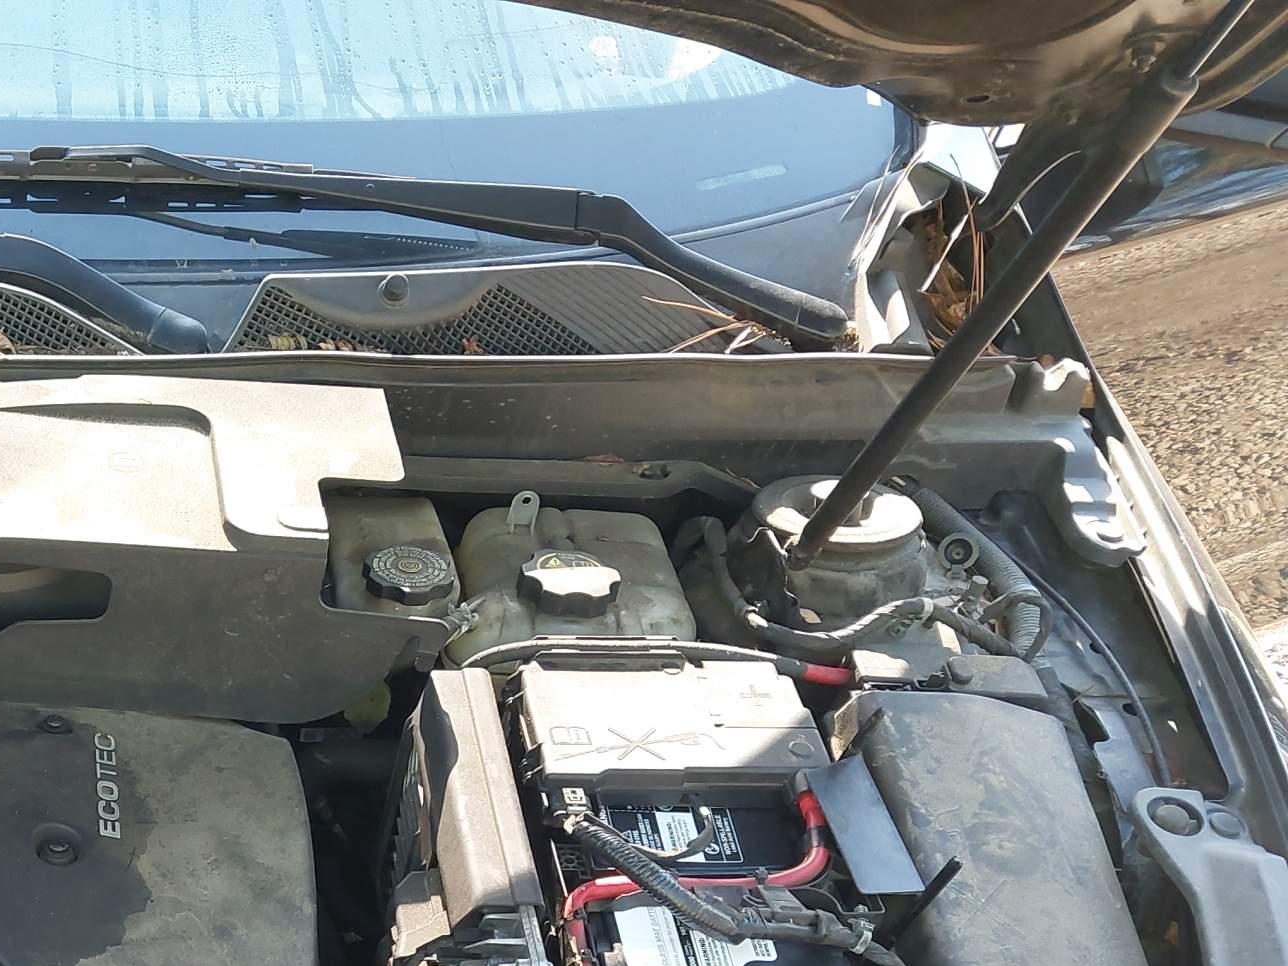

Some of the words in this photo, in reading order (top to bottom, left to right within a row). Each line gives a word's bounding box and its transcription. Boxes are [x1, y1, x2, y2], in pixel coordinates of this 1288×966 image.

[94, 732, 120, 839] ECOTEC
[714, 814, 732, 854] NON-SPILLABLE
[698, 938, 712, 966] WARNING!
